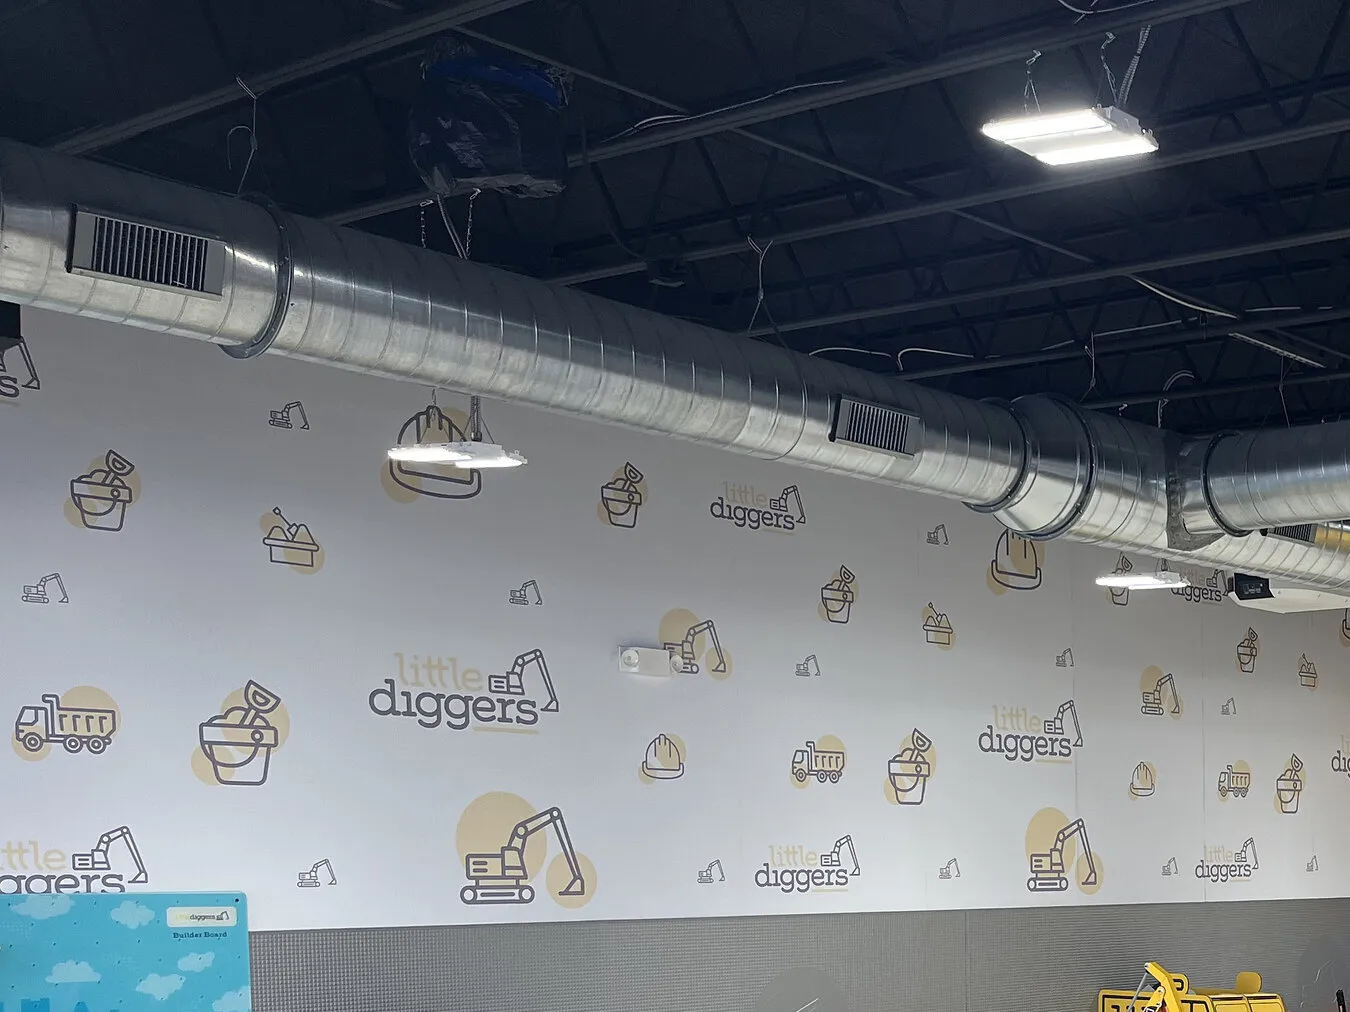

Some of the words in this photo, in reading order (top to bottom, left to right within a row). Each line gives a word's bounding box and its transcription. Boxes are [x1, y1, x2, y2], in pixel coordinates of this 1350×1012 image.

[710, 497, 795, 530] diggers
[393, 652, 483, 692] little
[368, 678, 539, 731] diggers
[992, 704, 1042, 733] little
[978, 725, 1072, 762] diggers
[0, 840, 67, 870] ttle
[768, 844, 818, 867] little
[1195, 859, 1251, 882] diggers
[755, 862, 849, 893] diggers
